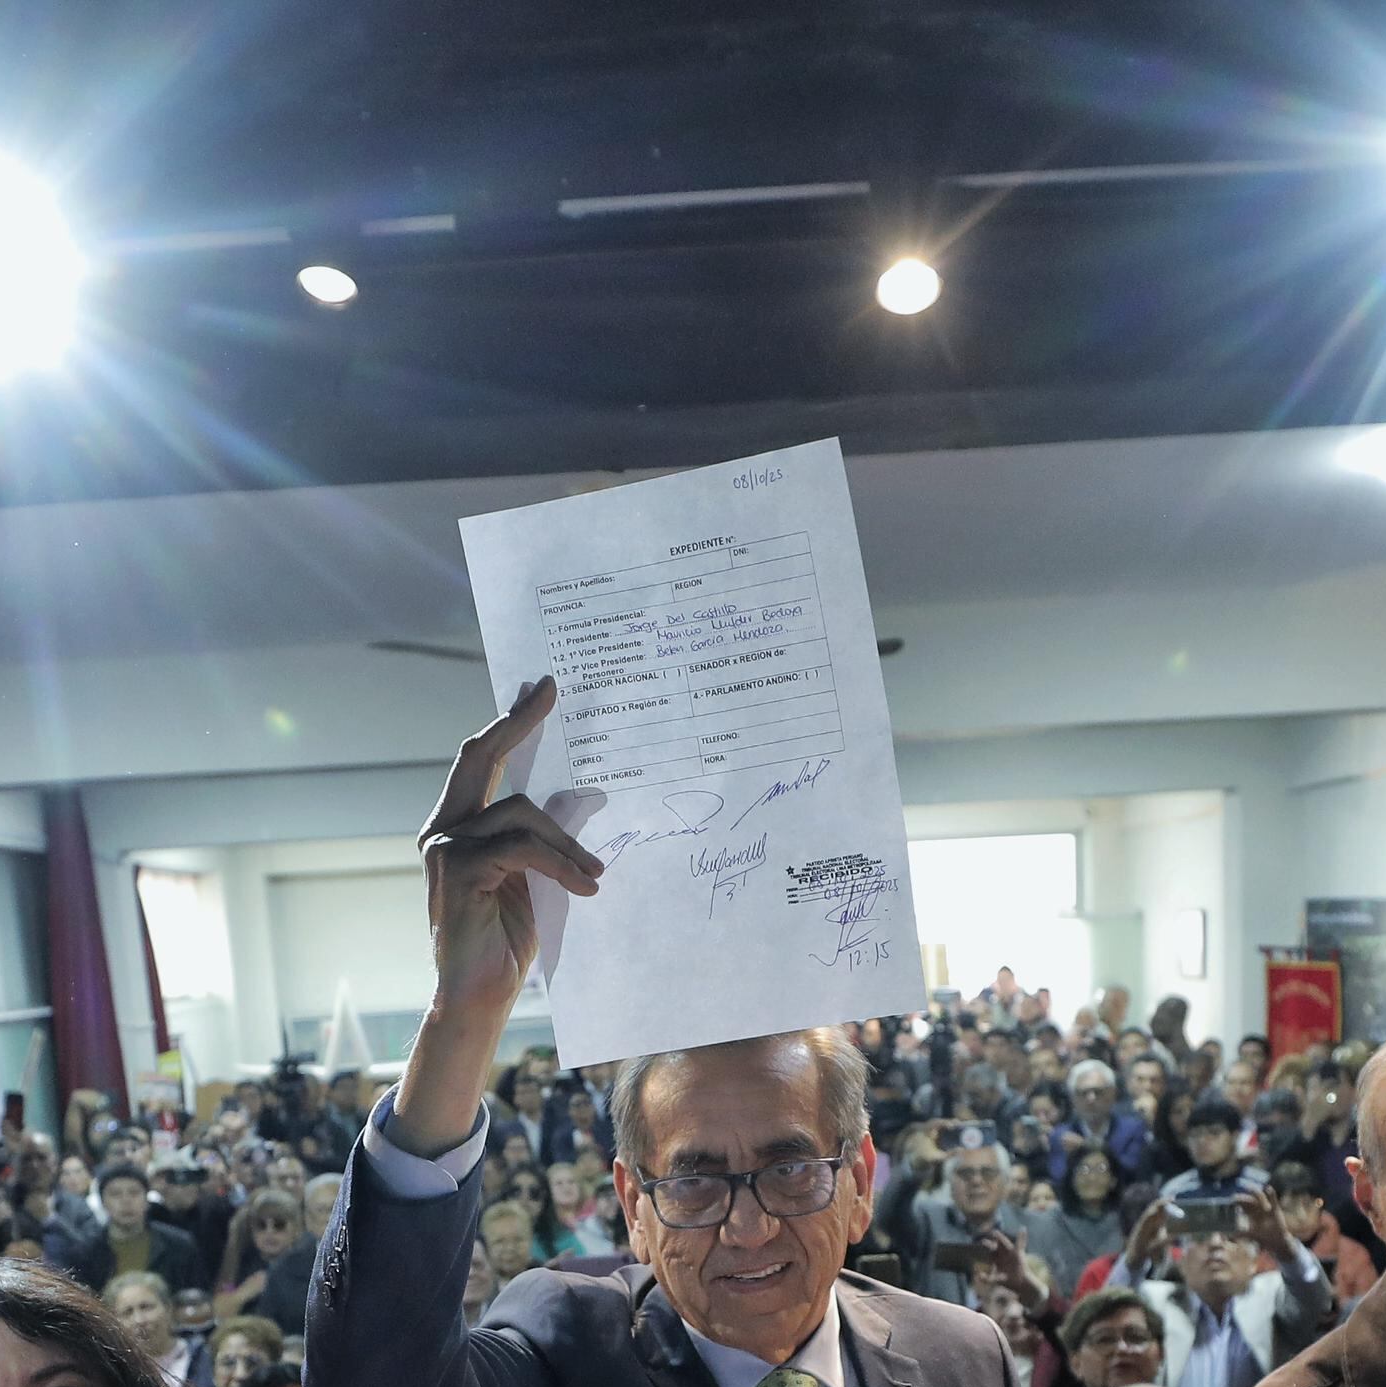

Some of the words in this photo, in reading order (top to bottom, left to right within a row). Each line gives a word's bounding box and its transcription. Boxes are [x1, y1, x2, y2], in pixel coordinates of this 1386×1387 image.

[669, 536, 725, 556] EXPEDIENTE
[733, 547, 749, 557] DNI:
[540, 584, 573, 596] Nombres
[580, 575, 615, 589] Apellidos:
[675, 578, 702, 590] REGION
[544, 602, 586, 615] PROVINCIA:
[558, 620, 591, 633] Fórmula
[594, 611, 646, 626] Presidencial:
[624, 620, 658, 635] Jorge
[668, 614, 685, 625] Del
[693, 603, 737, 620] Castillo
[566, 631, 612, 645] Presidente:
[657, 627, 702, 640] Mauricio
[579, 647, 596, 657] Vice
[599, 640, 644, 654] Presidente:
[581, 661, 599, 672] Vice
[601, 654, 646, 667] Presidente:
[689, 660, 730, 673] SENADOR
[740, 651, 772, 663] REGION
[774, 648, 786, 656] de:
[572, 681, 613, 694] SENADOR
[615, 672, 659, 685] NACIONAL
[705, 680, 763, 698] PARLAMENTO
[765, 673, 801, 686] ANDINO:
[576, 705, 619, 720] DIPUTADO
[629, 699, 656, 711] Región
[569, 734, 610, 748] DOMICILIO:
[701, 732, 740, 745] TELEFONO:
[572, 756, 604, 767] CORREO:
[704, 754, 728, 764] HORA:
[575, 776, 598, 786] FECHA
[600, 774, 609, 782] DE
[611, 769, 644, 780] INGRESO:
[798, 867, 872, 884] RECIBIDO
